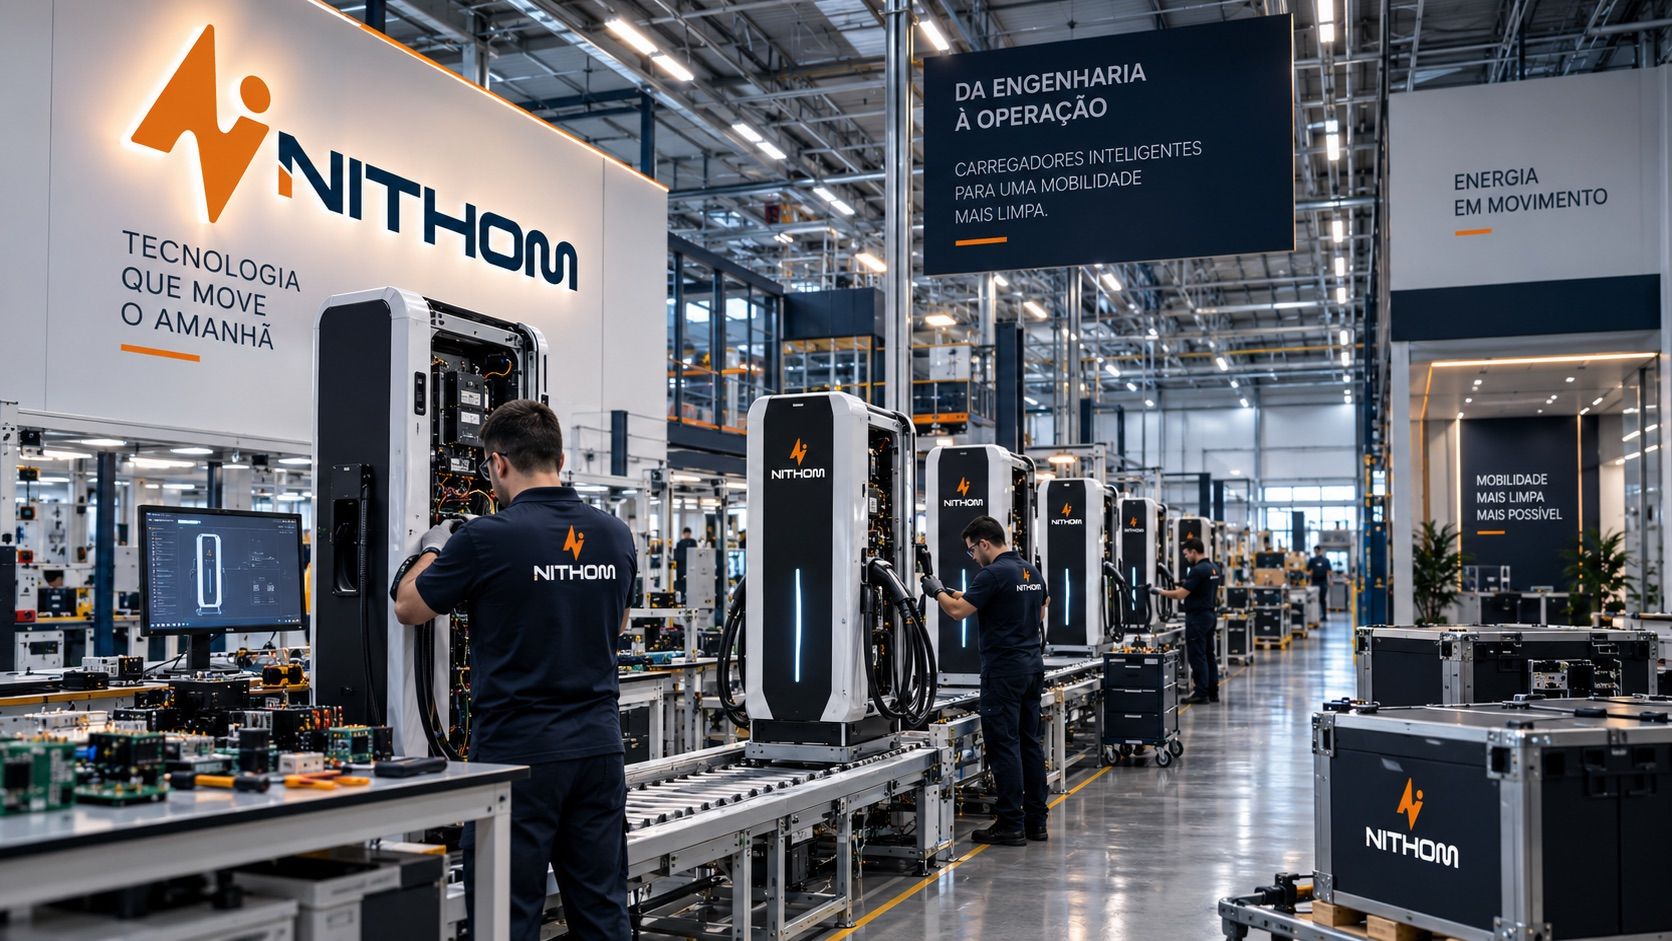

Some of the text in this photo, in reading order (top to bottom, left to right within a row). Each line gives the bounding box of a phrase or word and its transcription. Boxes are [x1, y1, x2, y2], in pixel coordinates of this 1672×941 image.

[955, 63, 1147, 101] DA ENGENHARIA
[955, 95, 1108, 132] À OPERAÇÃO
[955, 140, 1202, 177] CARREGADORES INTELIGENTES
[955, 169, 1142, 201] PARA UMA MOBILIDADE
[1455, 167, 1539, 190] ENERGIA
[278, 130, 578, 292] NITHOM
[955, 203, 1048, 224] MAIS LIMPA.
[1455, 188, 1608, 216] EM MOVIMENTO
[122, 229, 301, 293] TECNOLOGIA
[121, 266, 266, 316] QUE MOVE
[121, 302, 274, 350] O AMANHÃ
[771, 468, 825, 479] NITHOM
[1476, 473, 1548, 486] MOBILIDADE
[943, 499, 984, 507] NITHOM
[1476, 491, 1545, 504] MAIS LIMPA
[1476, 506, 1563, 520] MAIS POSSÍVEL
[533, 564, 617, 581] NITHOM
[1365, 826, 1459, 869] NITHOM
